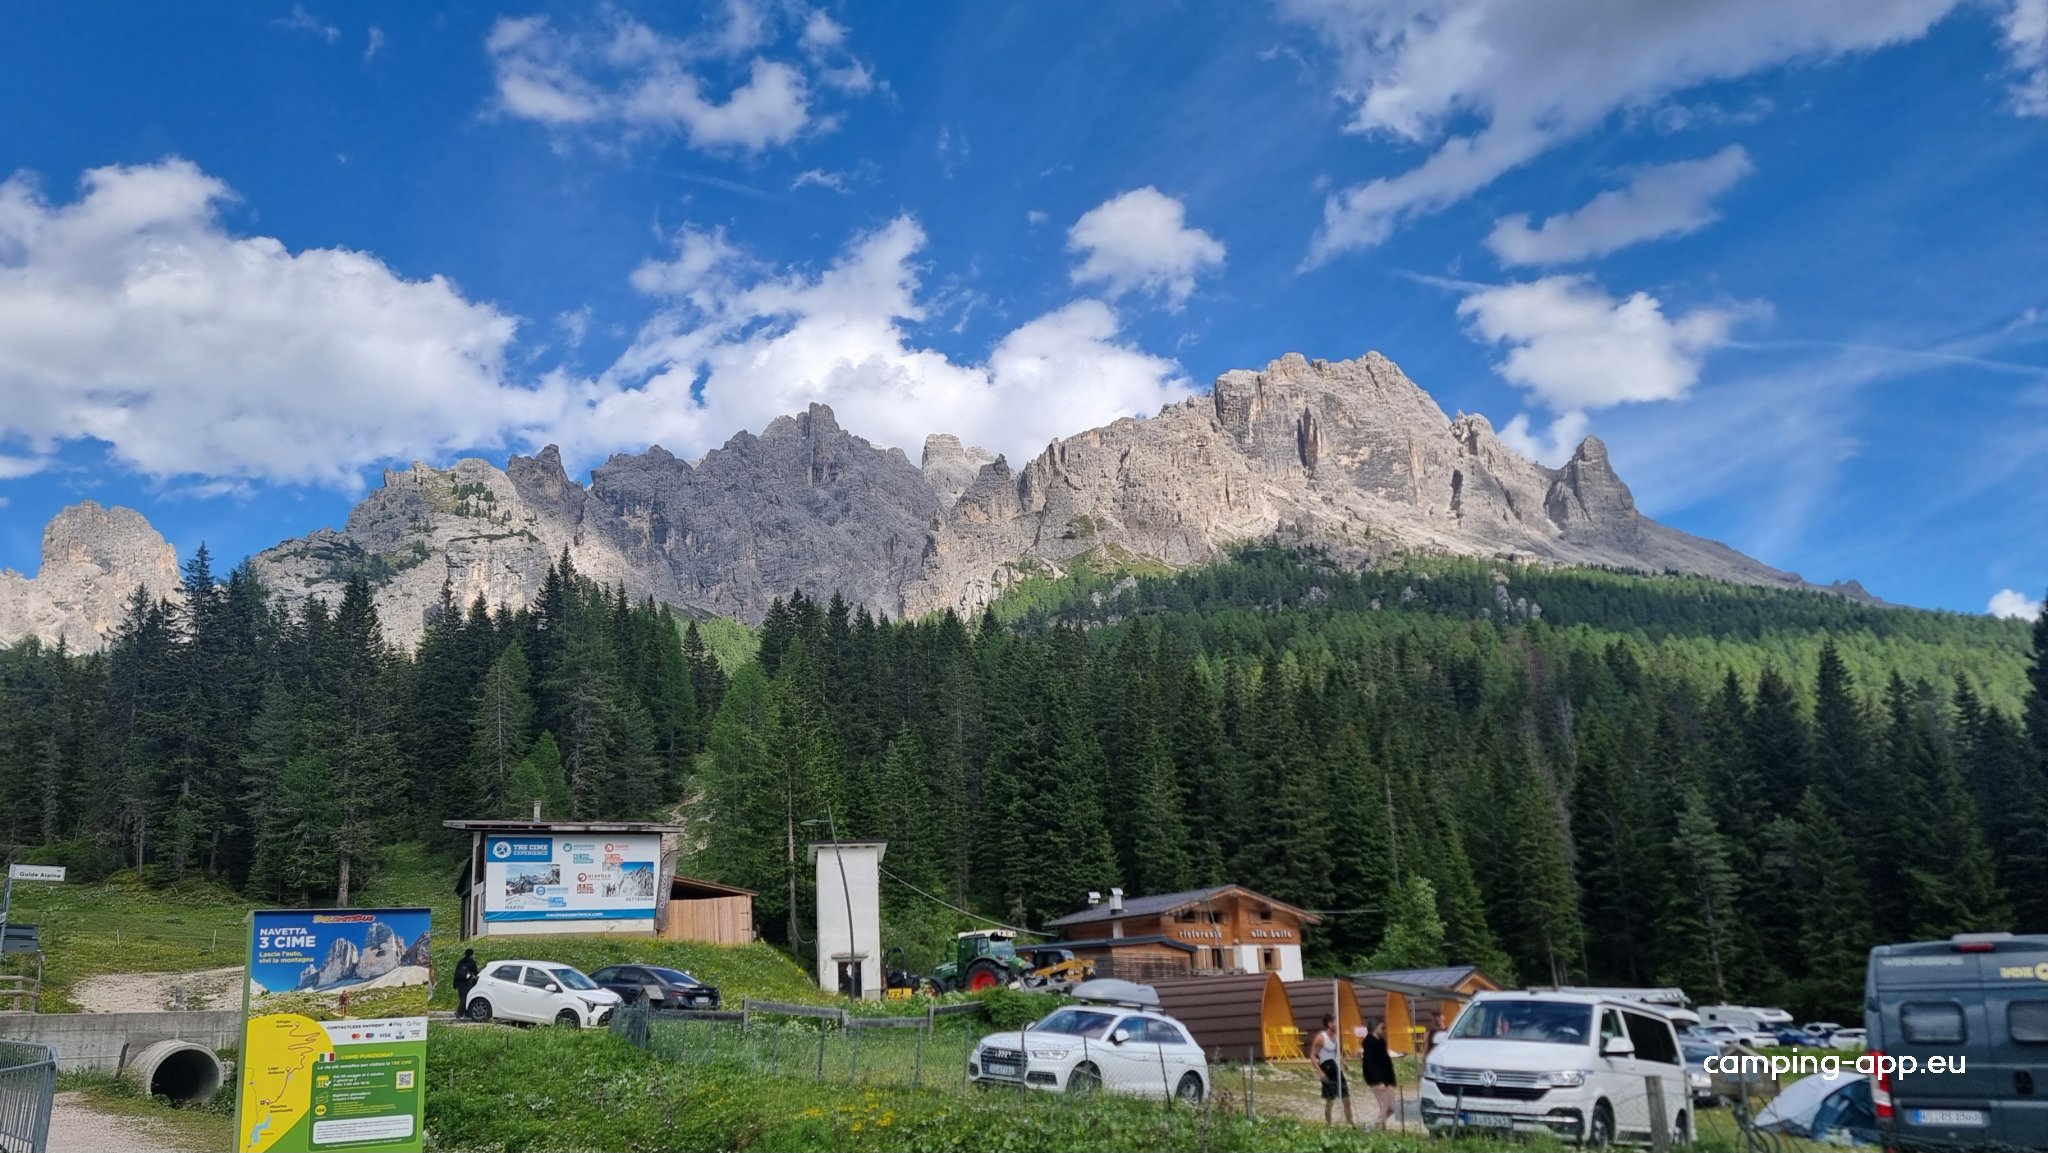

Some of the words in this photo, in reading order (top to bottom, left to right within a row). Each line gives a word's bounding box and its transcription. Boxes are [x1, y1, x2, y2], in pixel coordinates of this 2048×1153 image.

[260, 927, 307, 936] NAVETTA
[259, 937, 269, 949] 3
[274, 935, 316, 948] CIME
[282, 950, 303, 958] l'auto,
[280, 956, 314, 964] montagna
